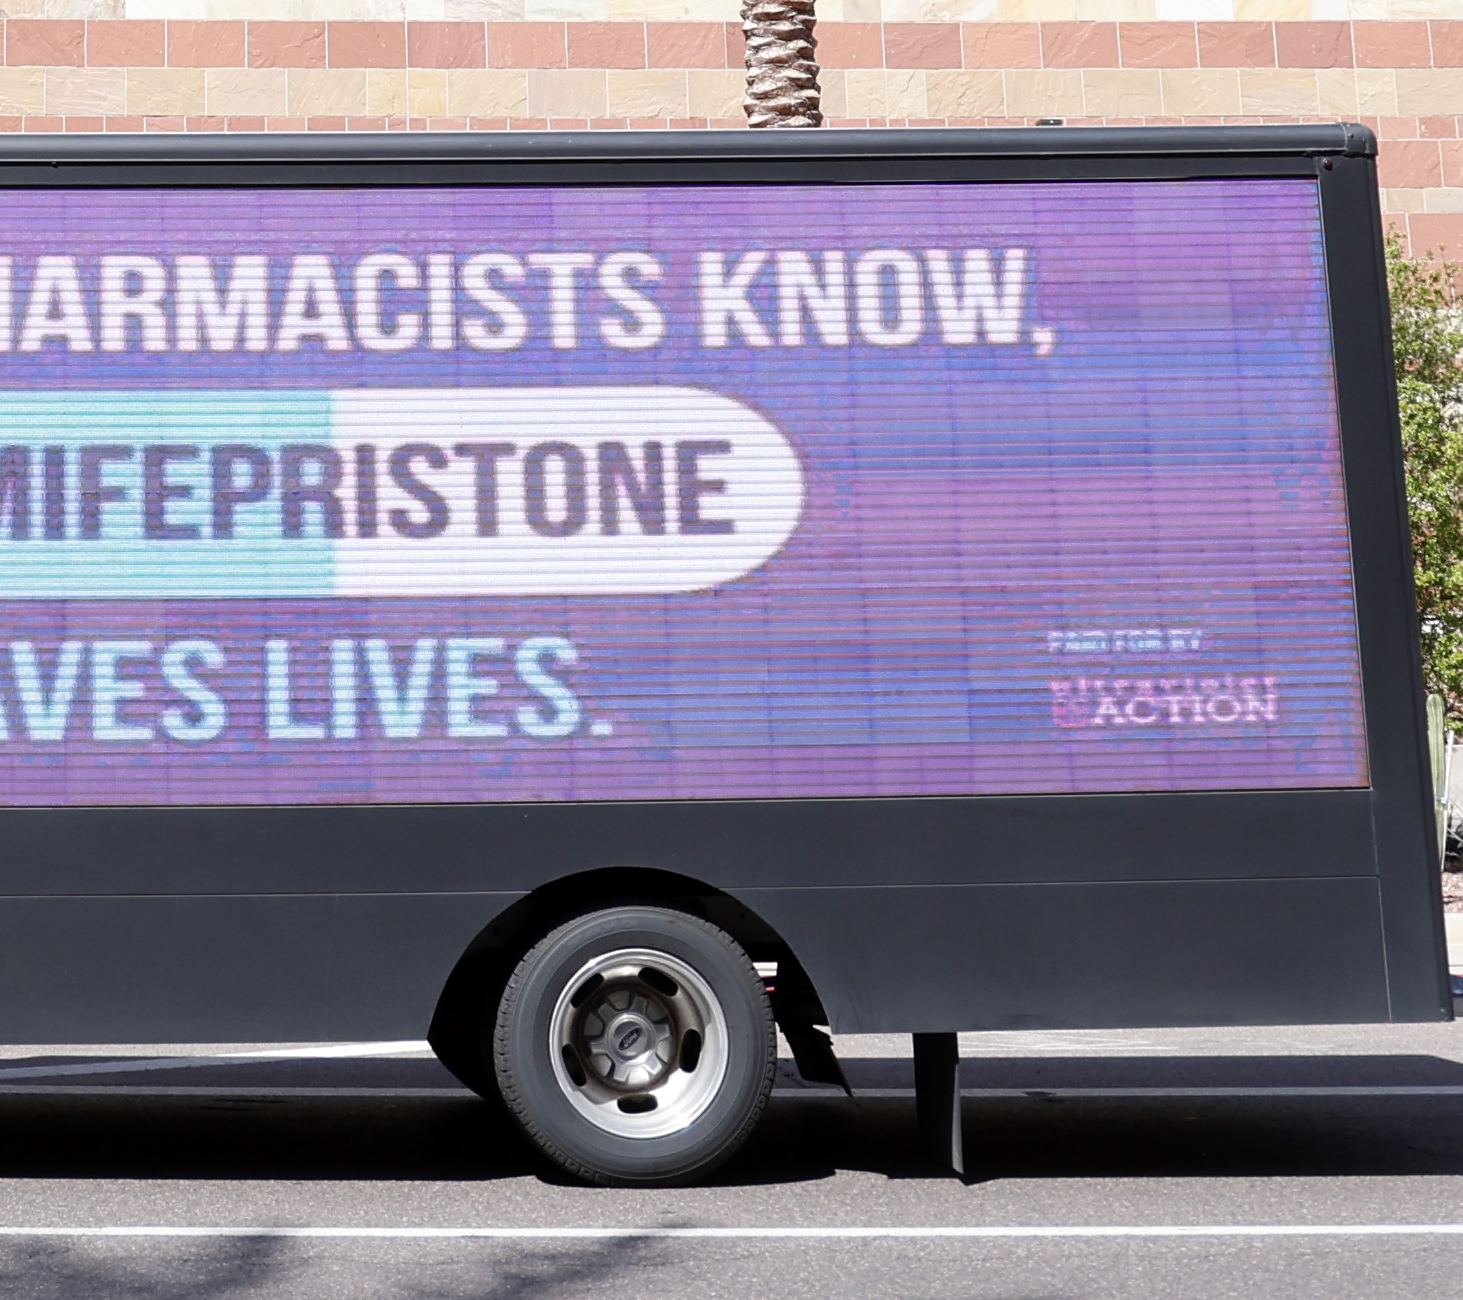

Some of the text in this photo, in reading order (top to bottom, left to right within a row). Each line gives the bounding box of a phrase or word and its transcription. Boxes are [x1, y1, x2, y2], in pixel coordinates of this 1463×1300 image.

[695, 247, 1058, 357] KNOW,
[263, 636, 616, 740] LIVES.
[1091, 694, 1280, 725] ACTION
